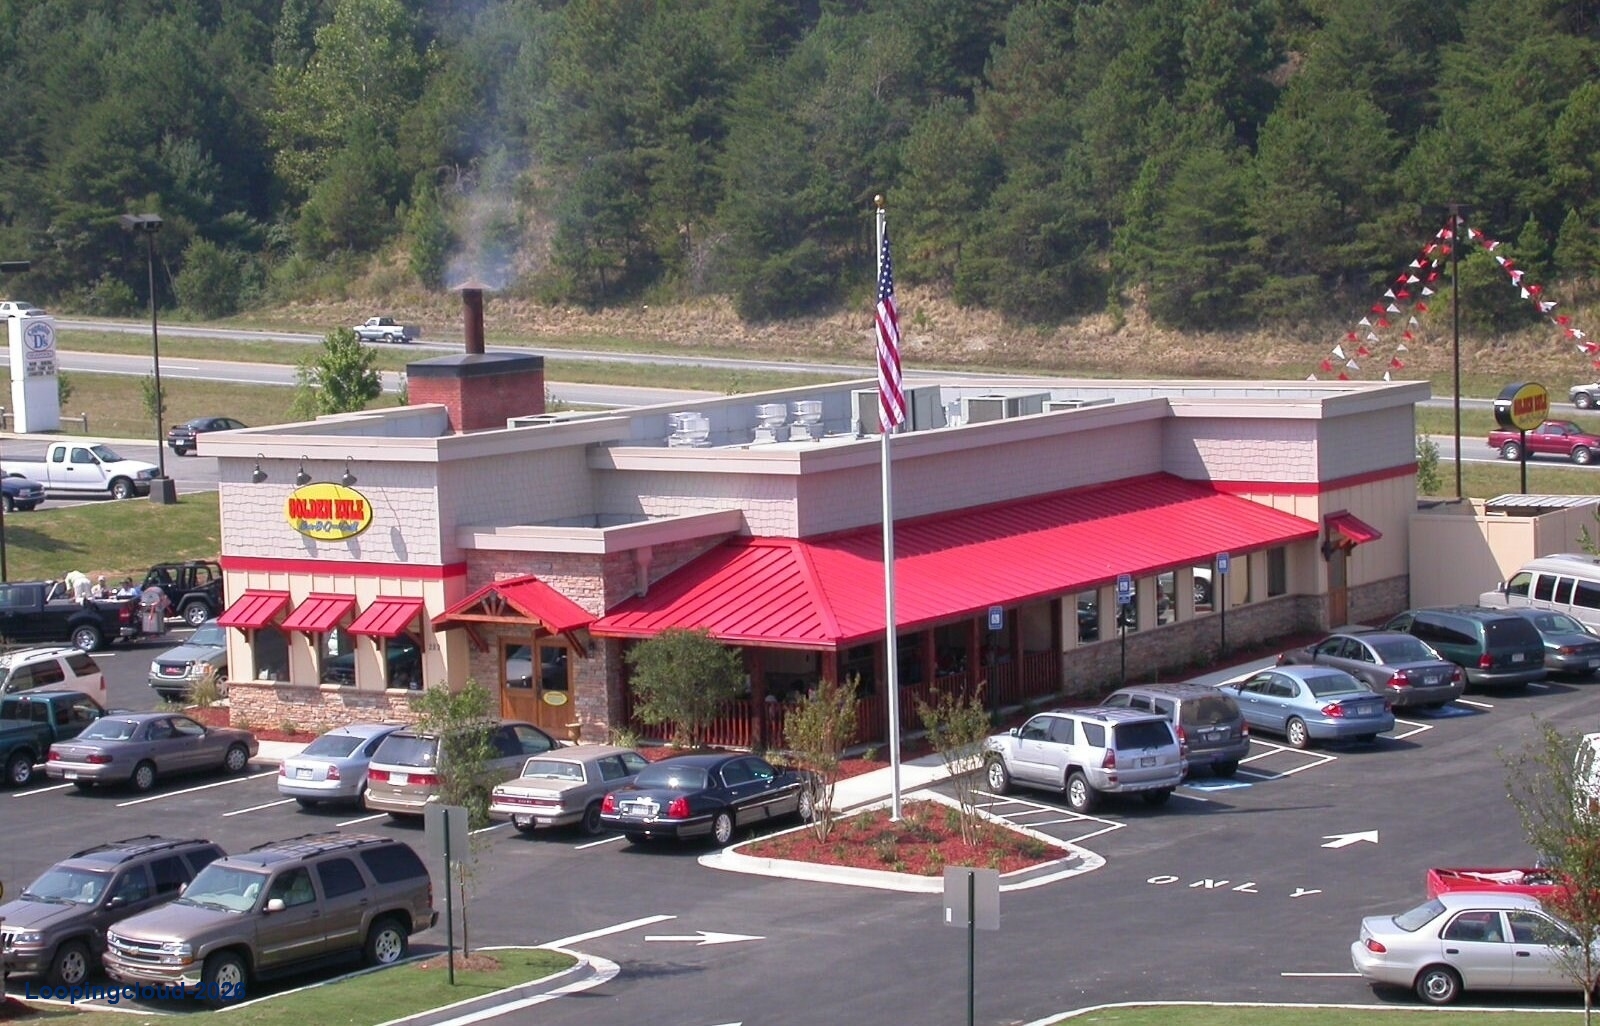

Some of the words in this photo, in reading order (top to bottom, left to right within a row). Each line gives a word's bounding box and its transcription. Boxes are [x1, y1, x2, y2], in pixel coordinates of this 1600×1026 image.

[288, 498, 332, 519] GOLDEN
[334, 499, 364, 520] RULE
[1147, 875, 1322, 897] ONLY
